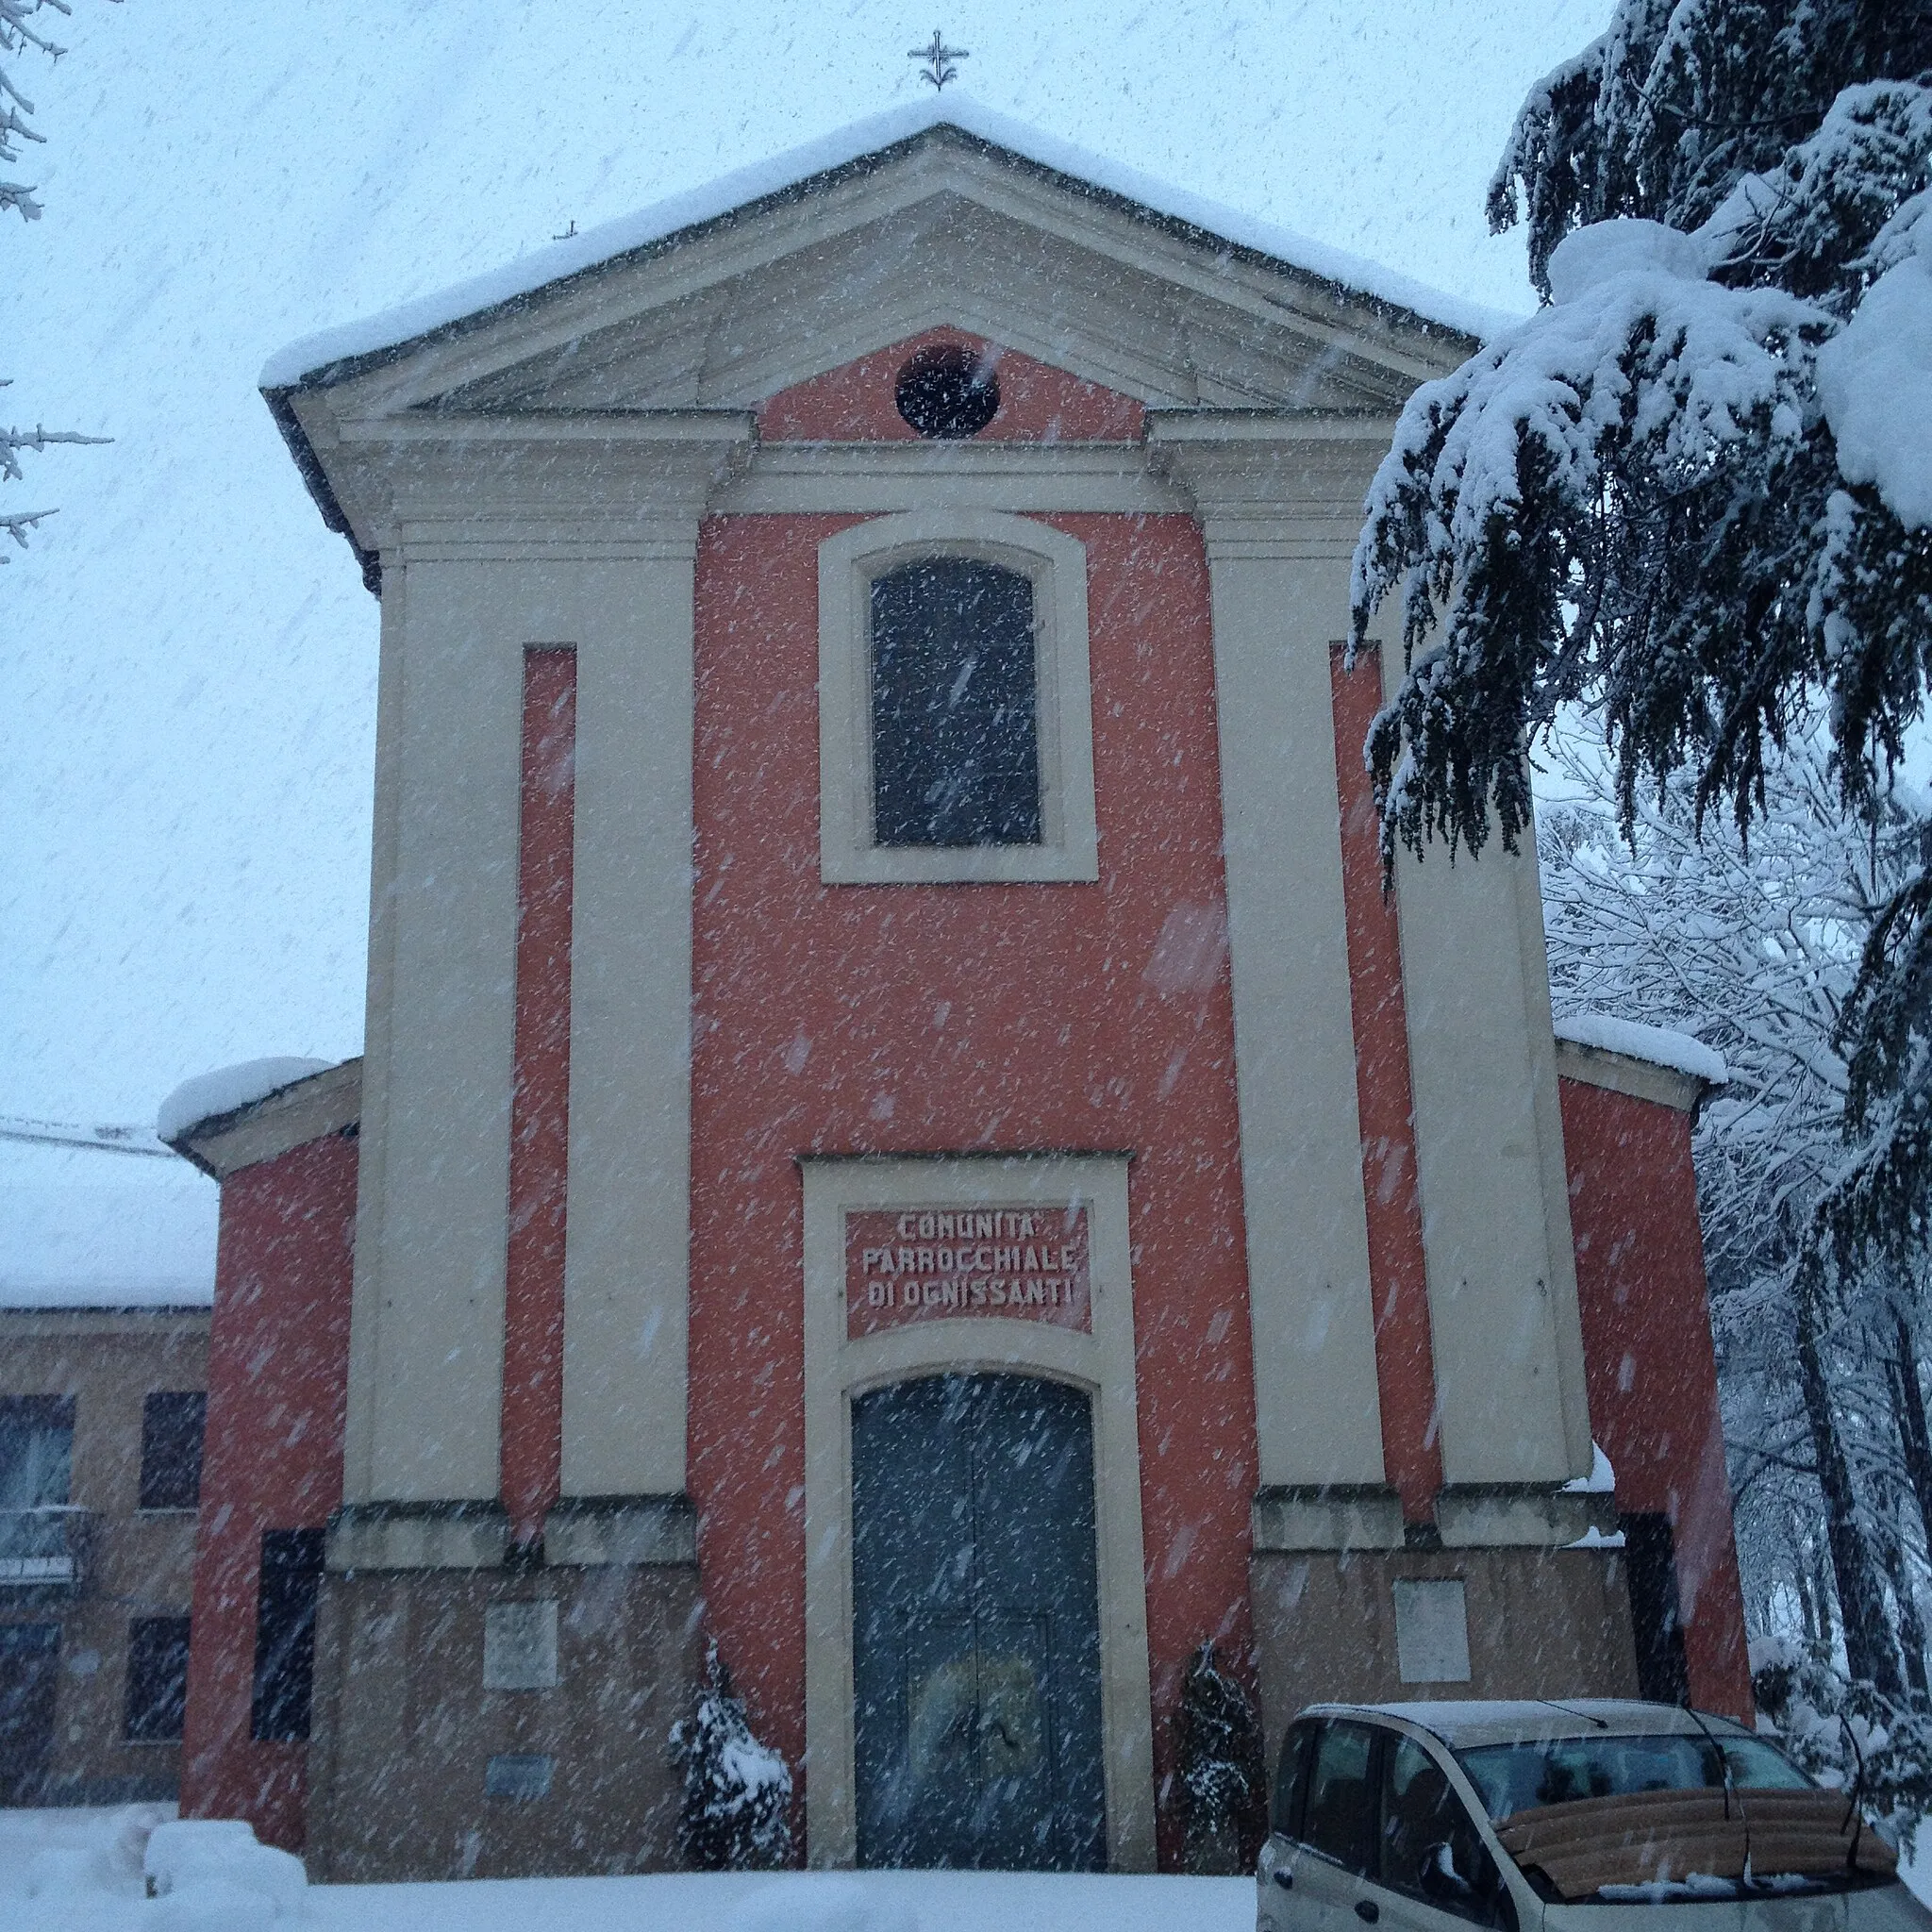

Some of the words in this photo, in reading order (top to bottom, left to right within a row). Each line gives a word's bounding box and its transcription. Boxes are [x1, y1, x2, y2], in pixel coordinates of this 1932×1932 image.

[862, 1245, 1077, 1274] PARROCCHIALE
[868, 1280, 895, 1307] DI
[904, 1278, 1073, 1307] OGNISSANTI
